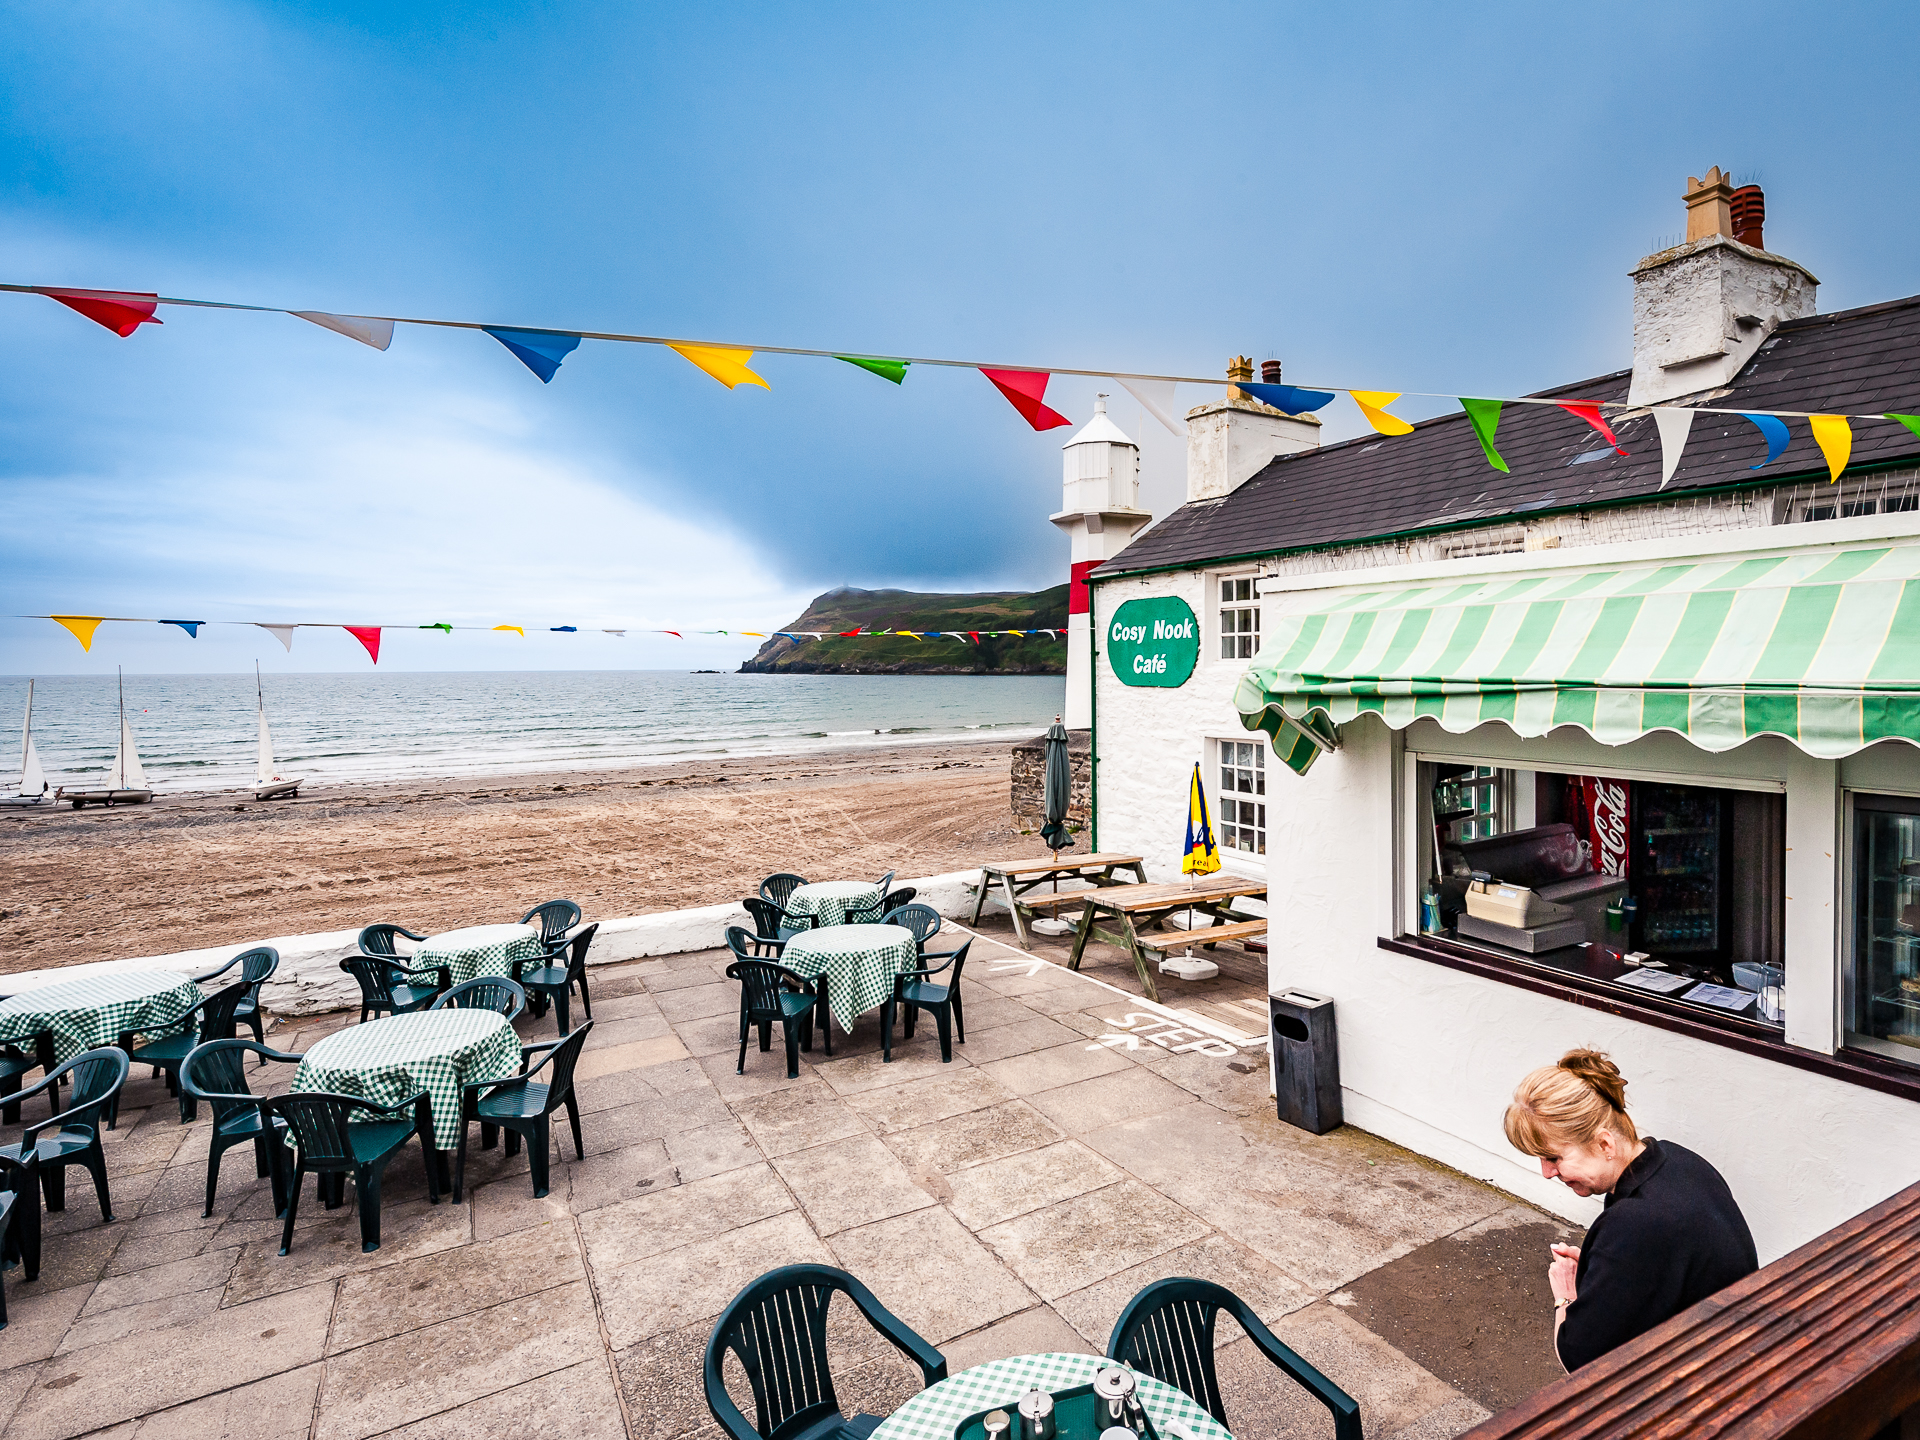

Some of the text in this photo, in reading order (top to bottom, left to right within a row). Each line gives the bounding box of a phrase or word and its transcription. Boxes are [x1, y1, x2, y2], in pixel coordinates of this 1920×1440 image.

[1112, 618, 1193, 644] Cosy Nook
[1133, 654, 1166, 674] Café
[1103, 1012, 1238, 1057] STEP
